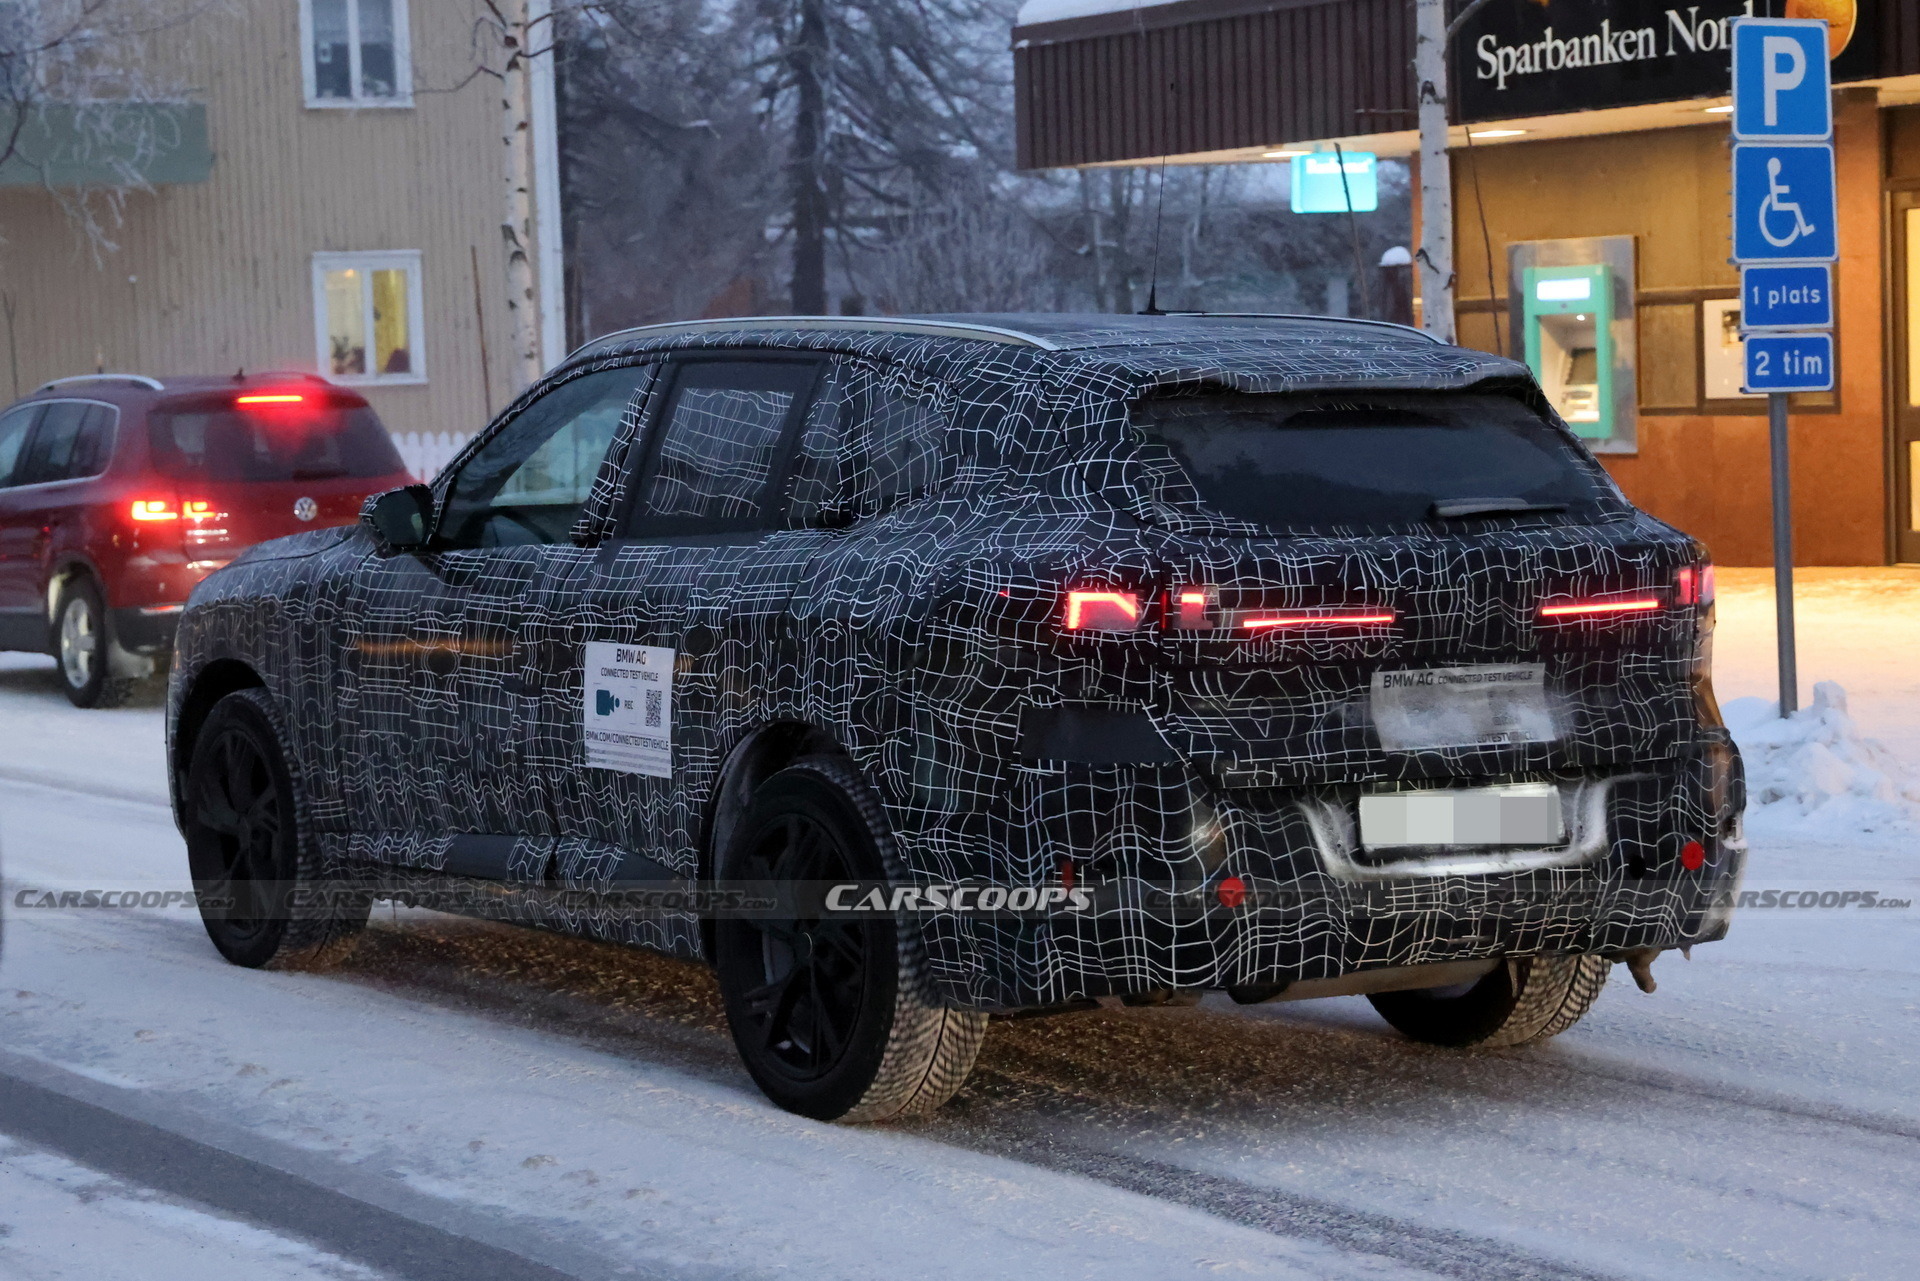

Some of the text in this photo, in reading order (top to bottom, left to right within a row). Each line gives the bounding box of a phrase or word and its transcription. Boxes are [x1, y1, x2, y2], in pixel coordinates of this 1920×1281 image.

[1476, 18, 1657, 90] Sparbanken
[1763, 36, 1807, 126] P
[1752, 285, 1821, 309] 1 plats
[1755, 350, 1823, 376] 2 tim
[616, 648, 647, 665] BMW AG
[601, 667, 659, 682] CONNECTED TEST VEHICLE
[1383, 670, 1533, 688] BMW AG CONNECTED TEST VEHICLE
[624, 699, 634, 710] REC
